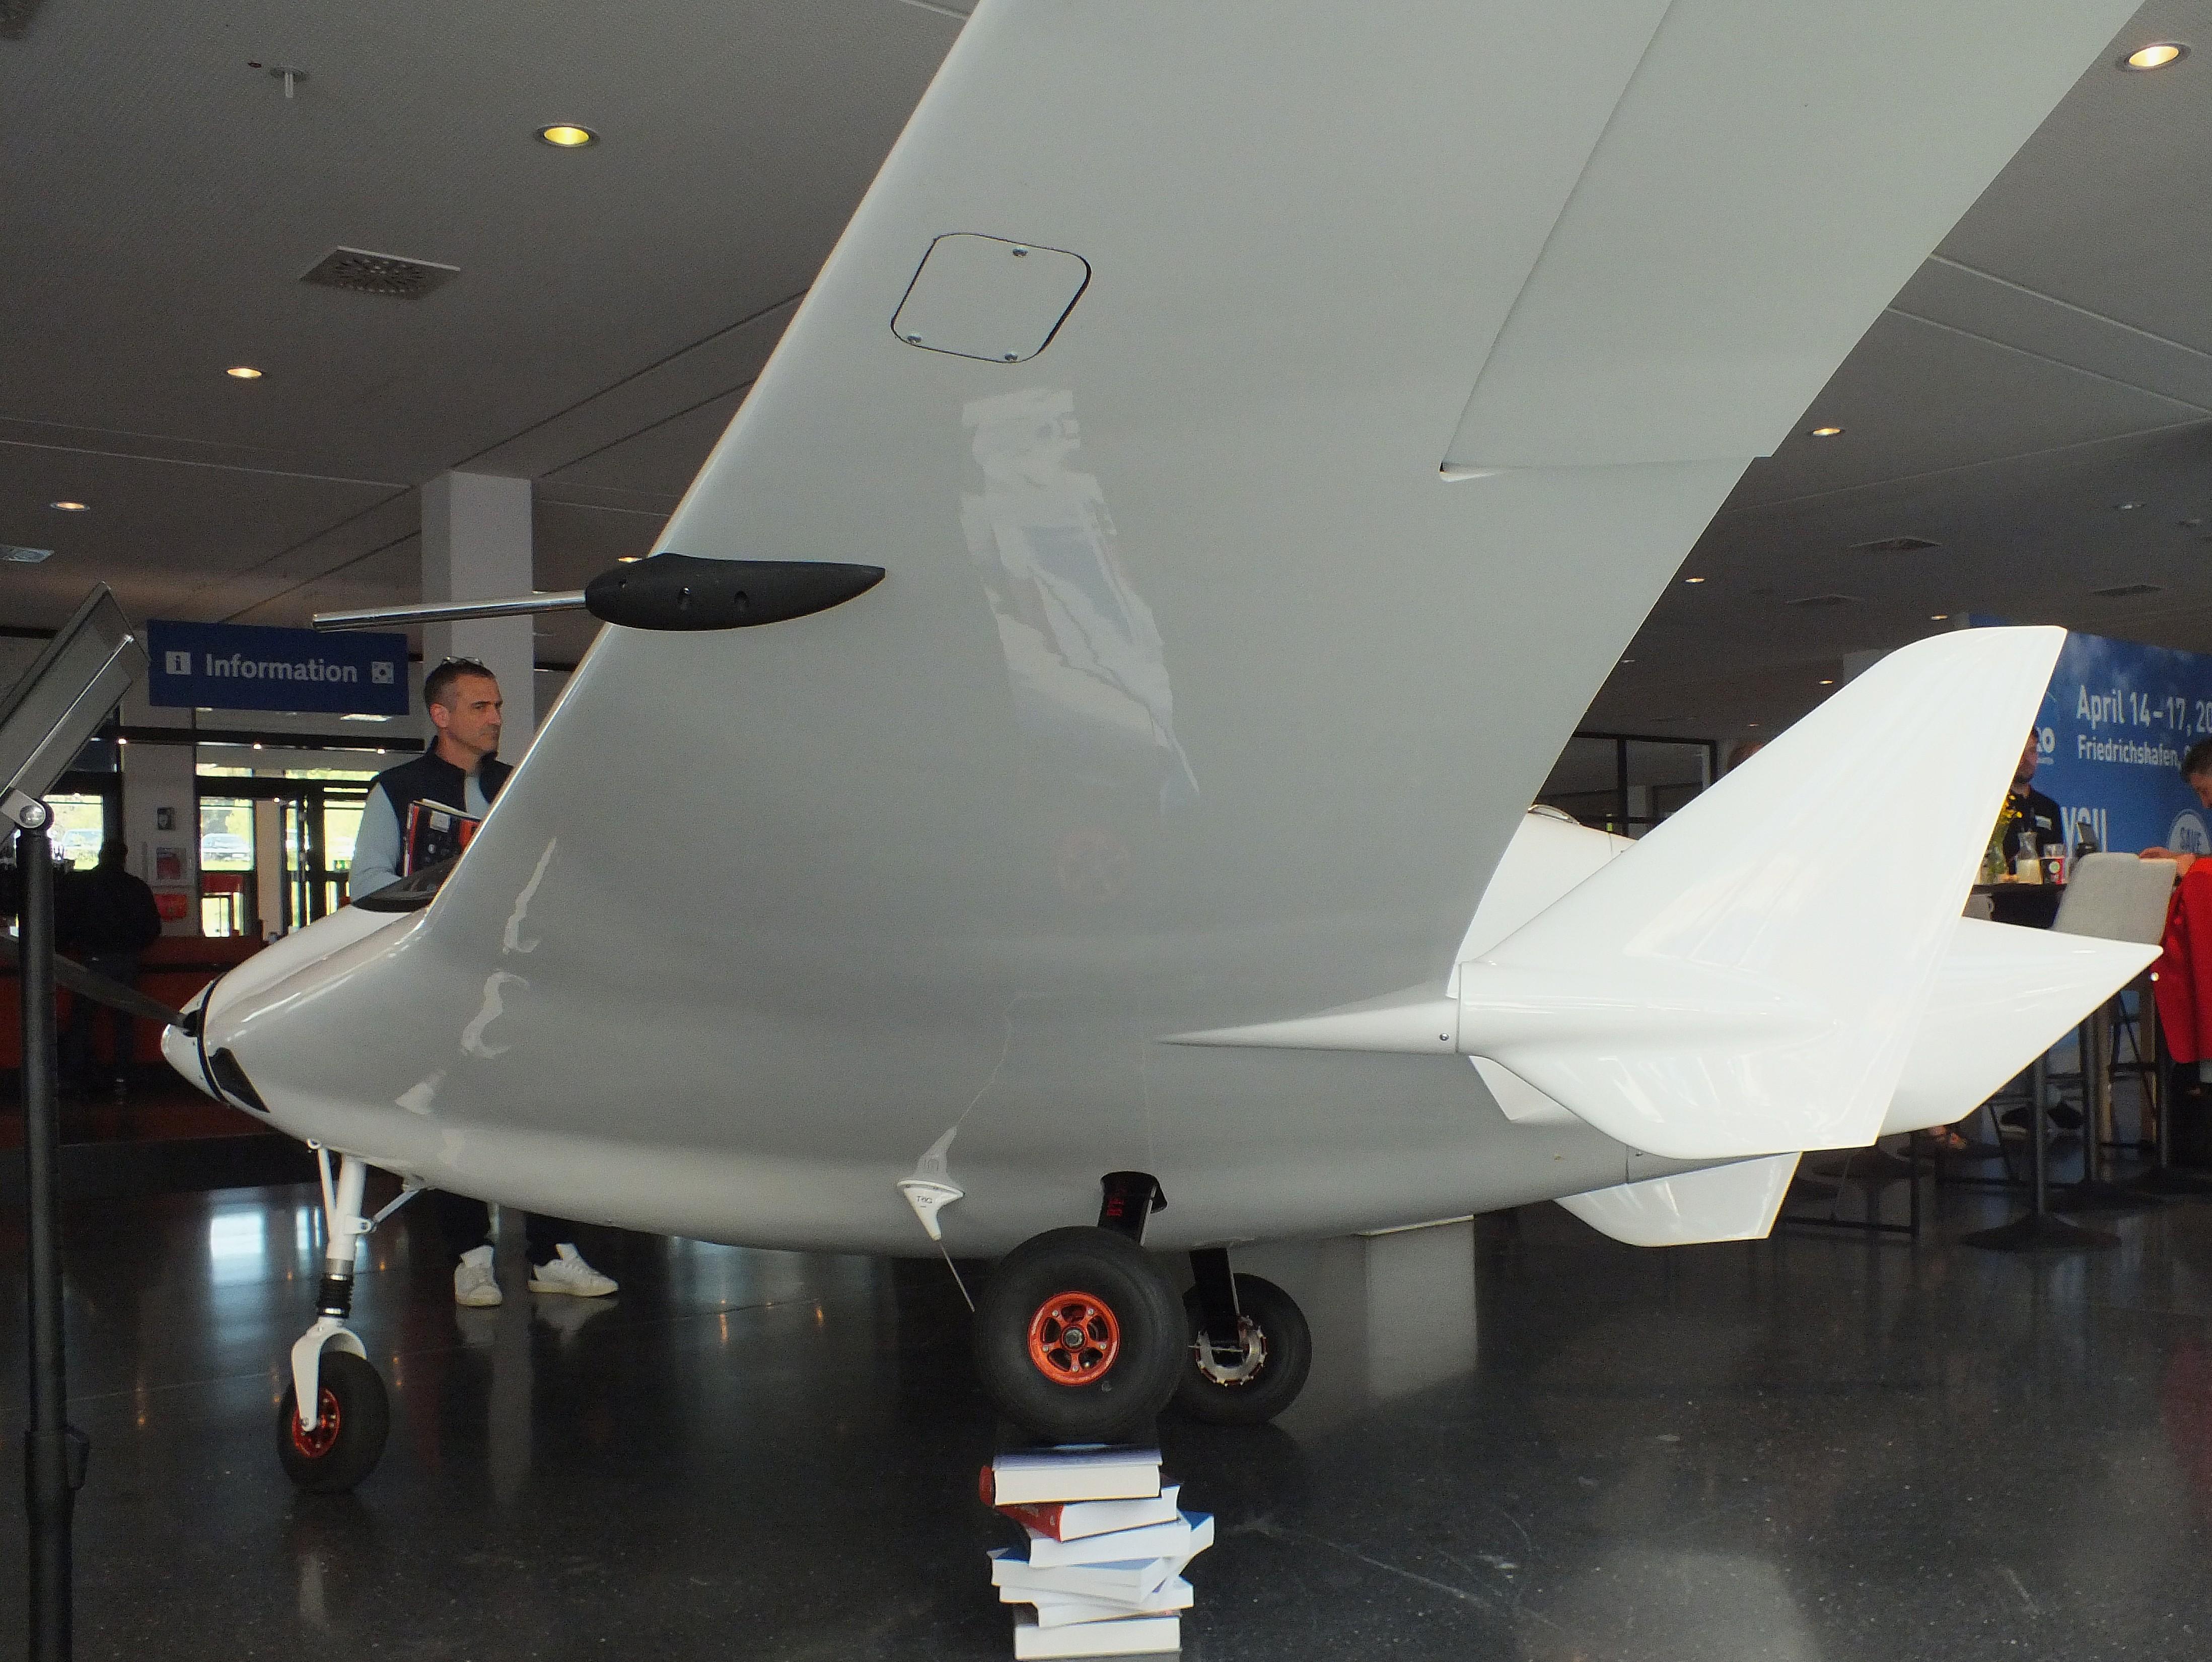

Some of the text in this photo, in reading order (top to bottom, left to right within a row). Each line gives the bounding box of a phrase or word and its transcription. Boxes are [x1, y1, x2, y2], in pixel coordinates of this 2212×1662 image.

[206, 654, 358, 682] Information
[2077, 685, 2125, 730] April
[2078, 734, 2182, 770] Friedrichshafen,
